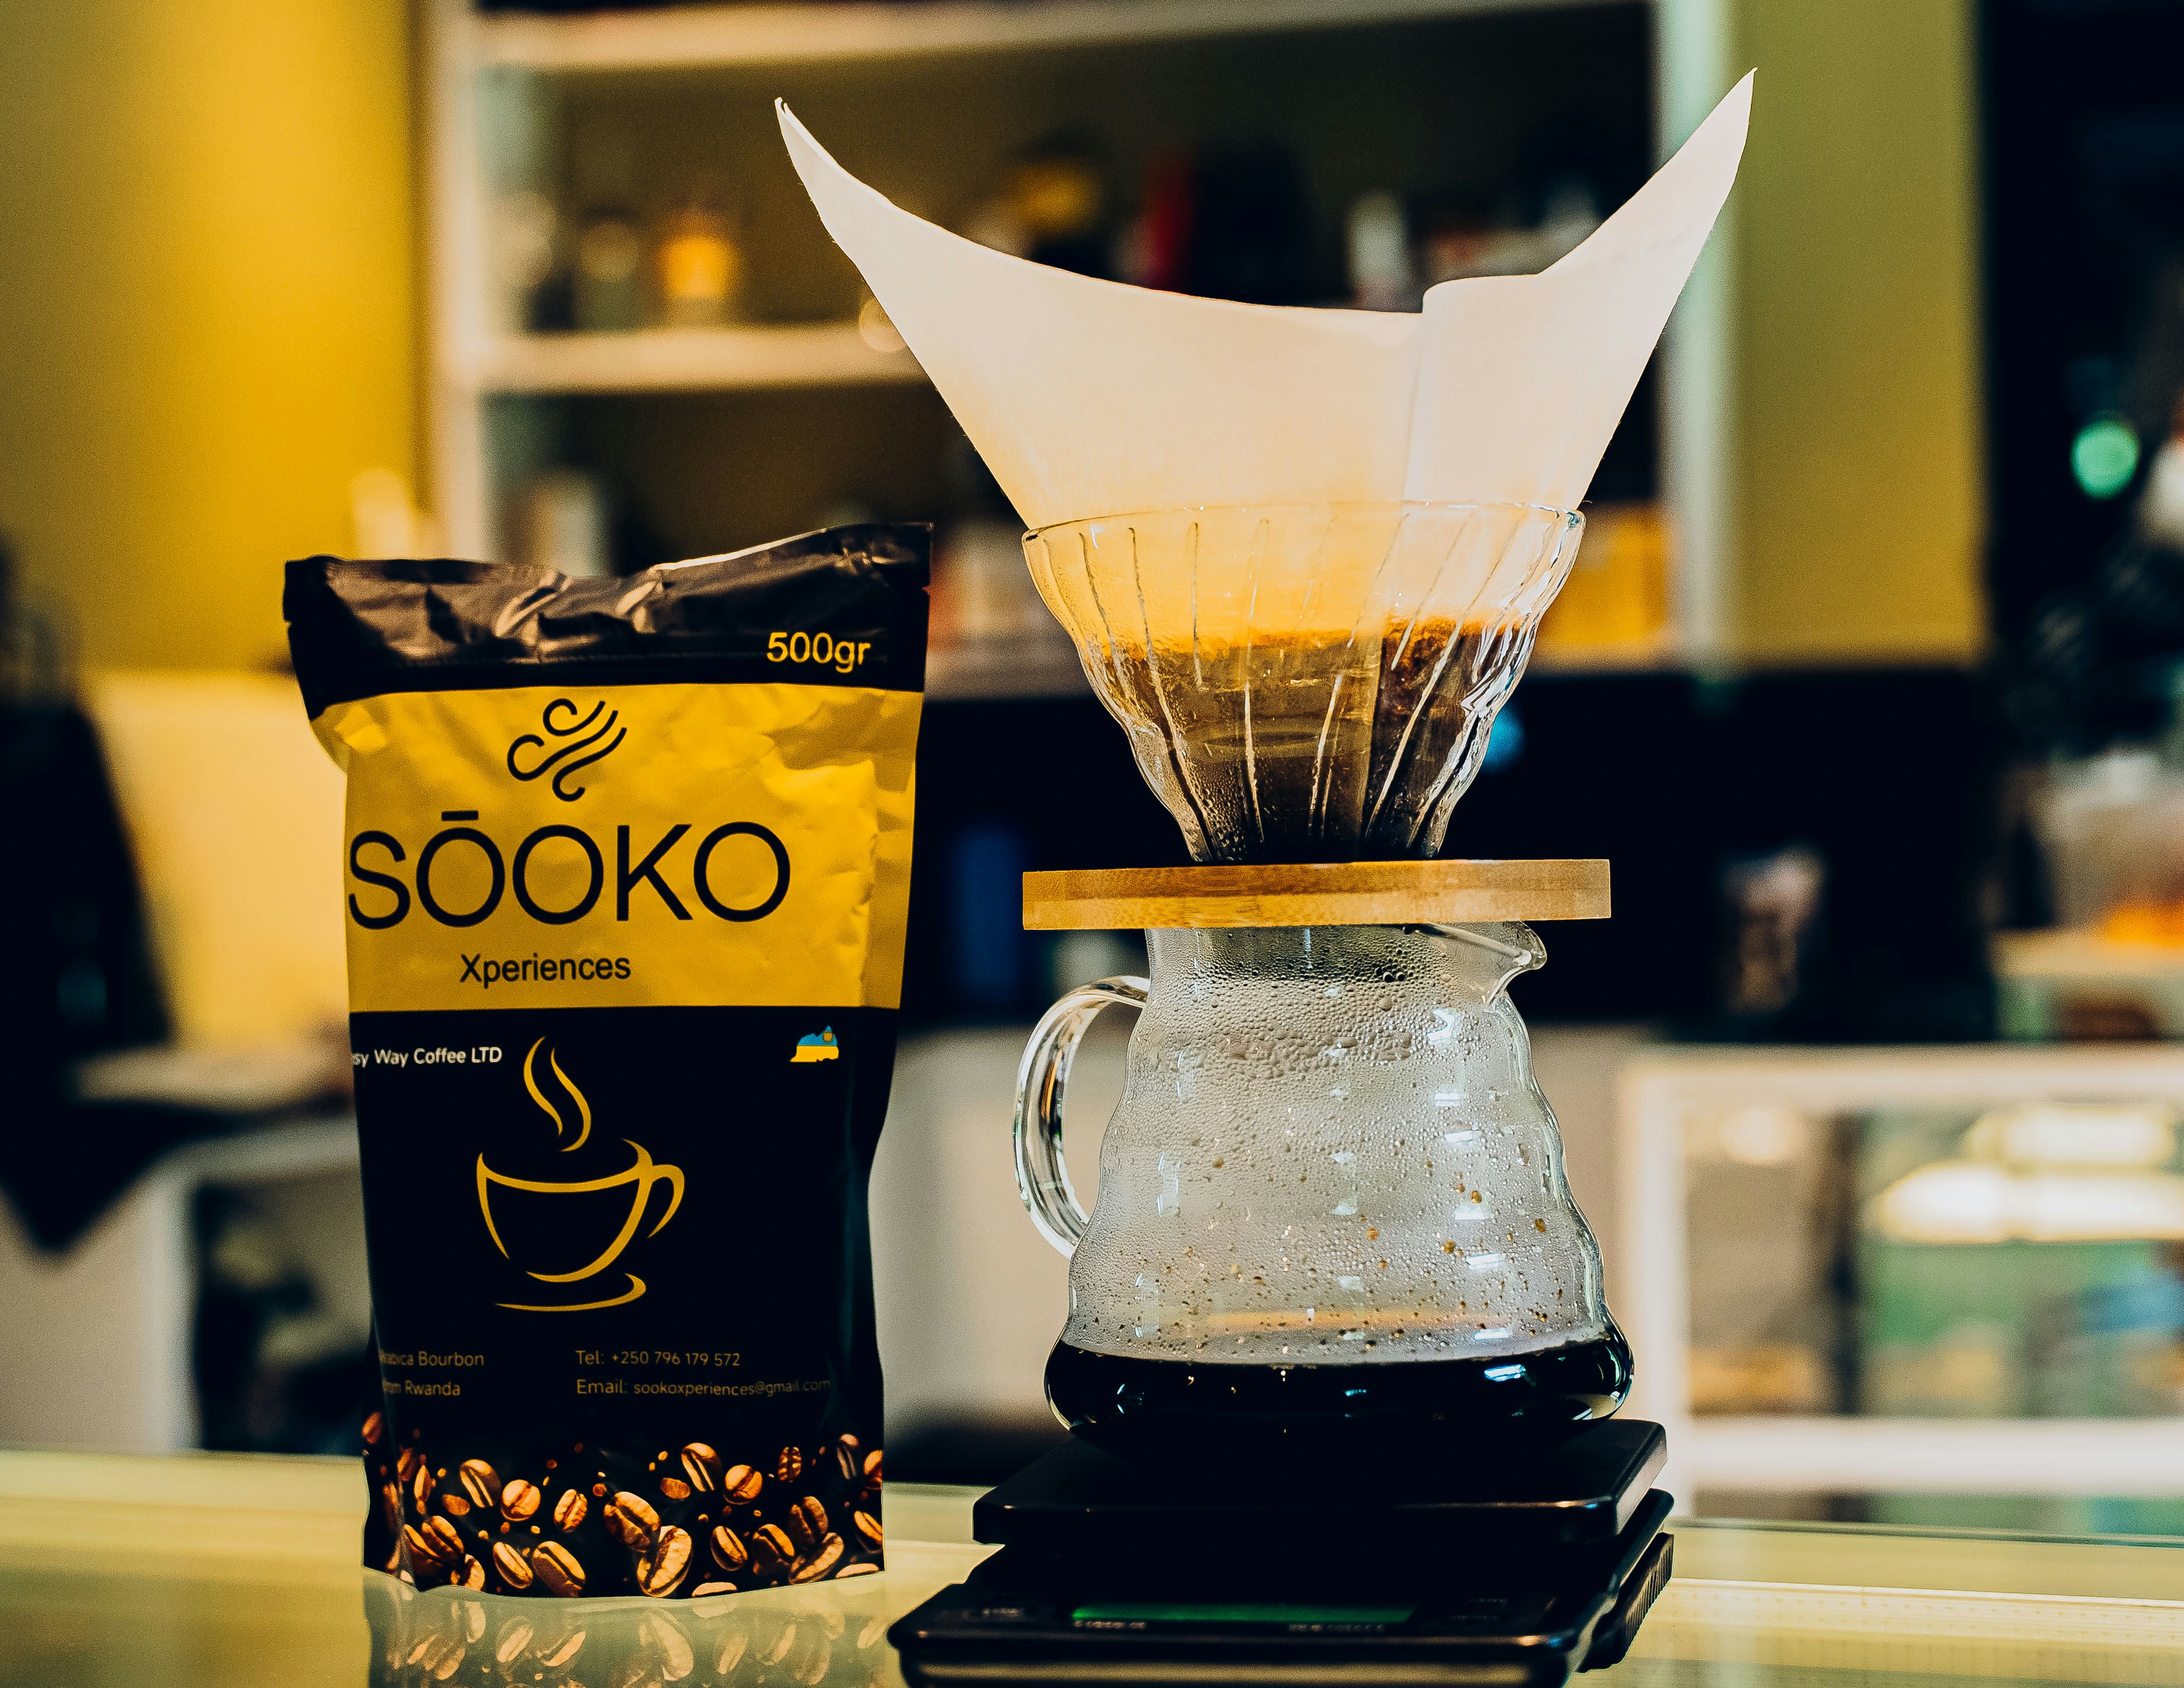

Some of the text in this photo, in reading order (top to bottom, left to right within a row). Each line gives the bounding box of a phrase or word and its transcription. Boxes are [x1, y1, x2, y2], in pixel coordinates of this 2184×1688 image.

[767, 632, 871, 673] 500gr
[460, 952, 632, 990] Xperiences
[352, 1047, 503, 1068] sy Way Coffee LTD
[419, 1351, 484, 1366] Bourbon
[576, 1350, 740, 1367] Tel: +250 796 179 572
[405, 1380, 461, 1397] Rwanda
[577, 1379, 830, 1397] Email: sookoxperiences@gmail.com
